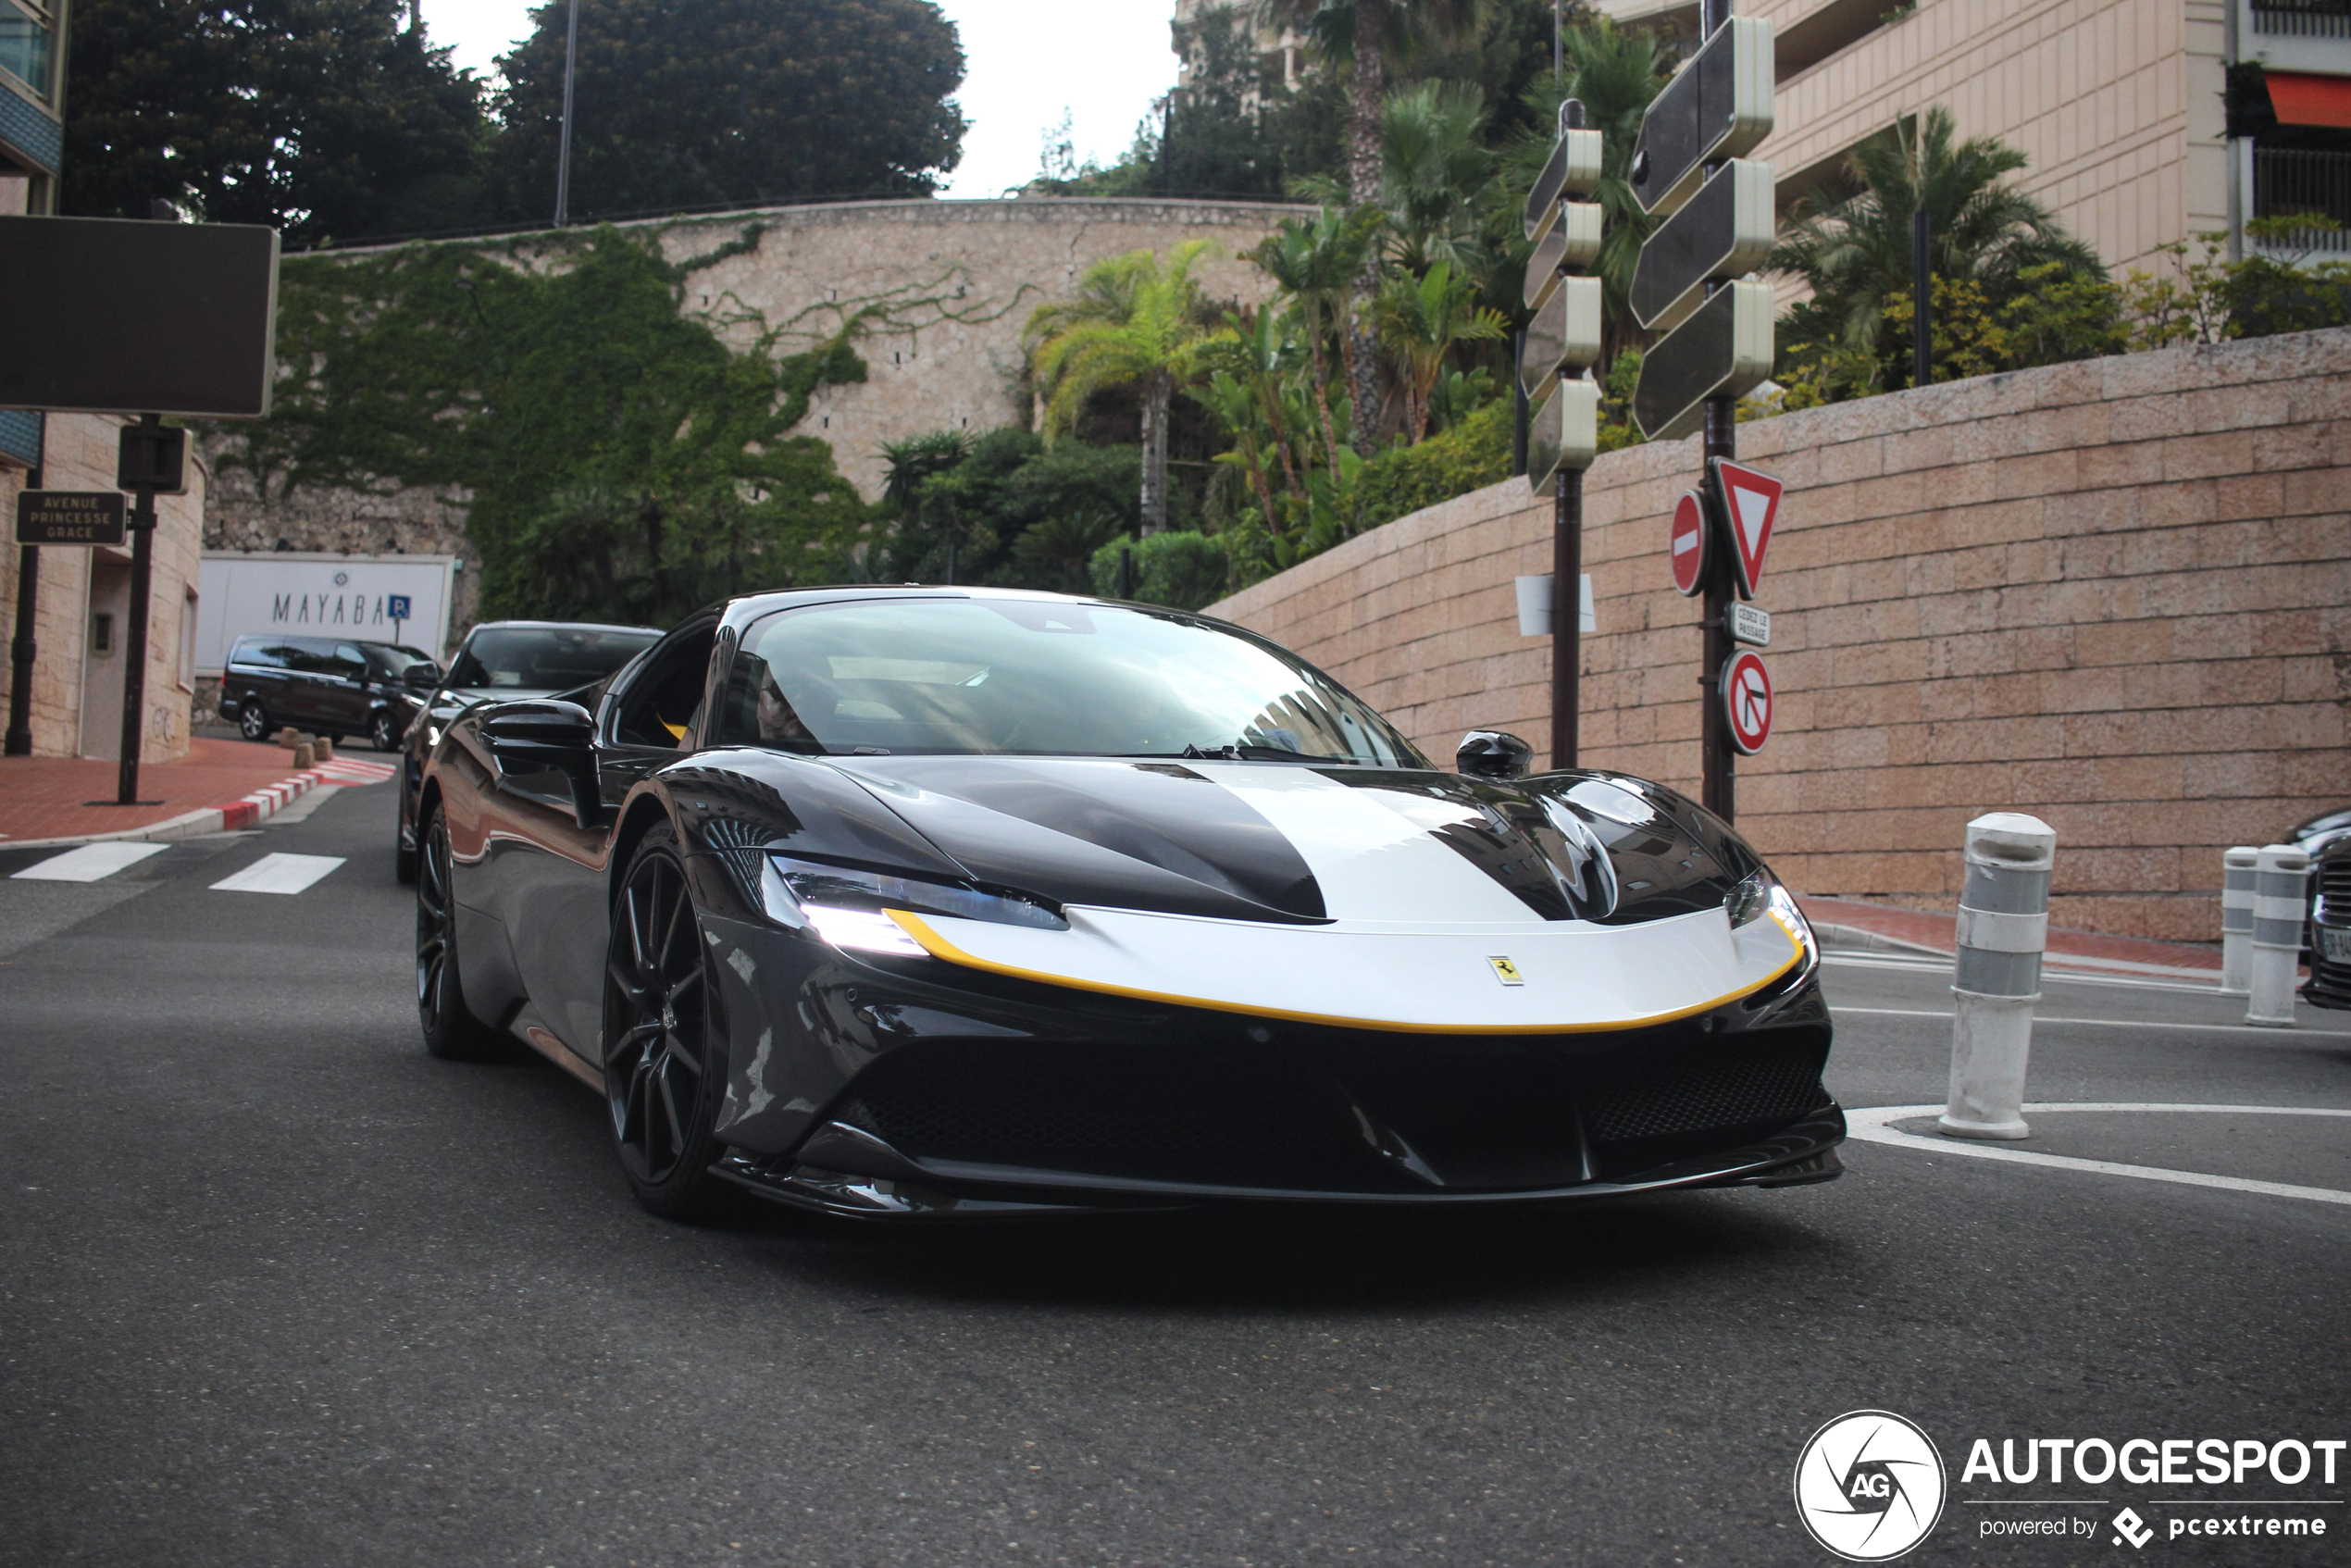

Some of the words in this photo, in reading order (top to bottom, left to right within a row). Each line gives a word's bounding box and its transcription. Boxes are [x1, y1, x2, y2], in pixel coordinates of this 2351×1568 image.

[44, 497, 99, 510] AVENUE
[31, 512, 110, 525] PRINCESSE
[46, 527, 93, 538] GRACE
[272, 593, 383, 625] MAYABA
[394, 599, 405, 615] P
[1760, 614, 1767, 627] LE
[1738, 622, 1767, 641] PASSAGE
